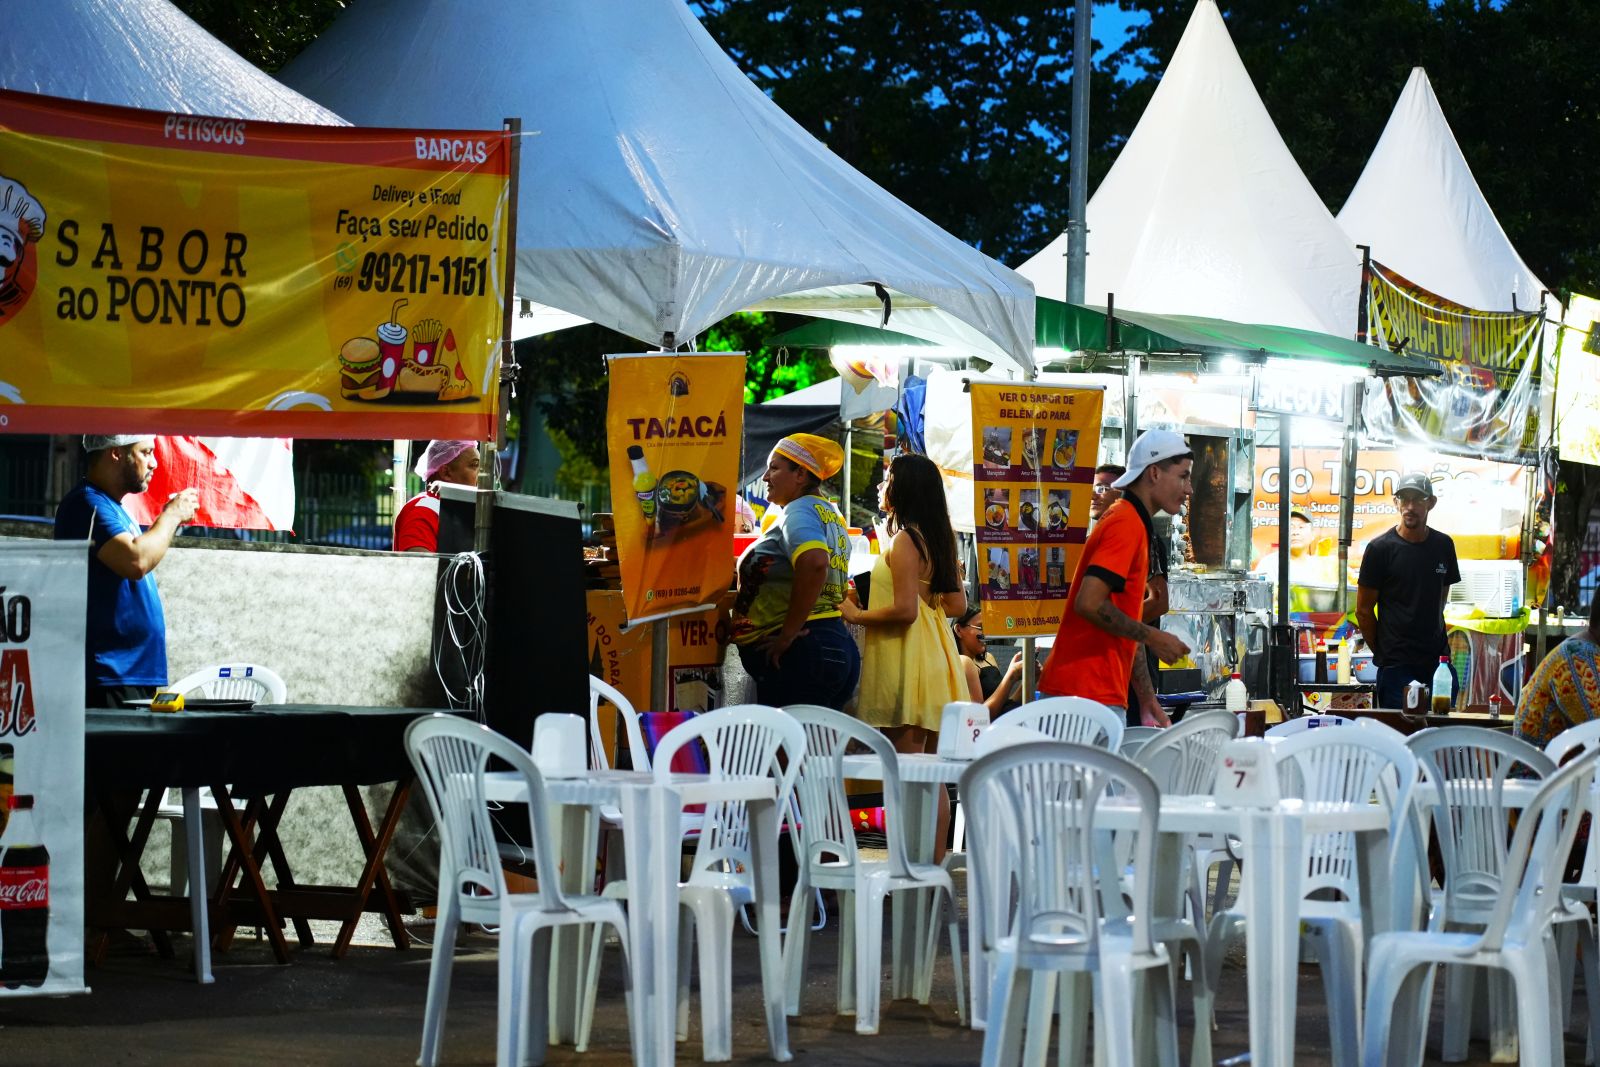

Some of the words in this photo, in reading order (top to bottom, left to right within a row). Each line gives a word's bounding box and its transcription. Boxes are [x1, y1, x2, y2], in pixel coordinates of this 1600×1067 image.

[163, 114, 247, 146] PETISCOS
[414, 136, 487, 164] BARCAS
[372, 184, 415, 208] Delivey
[418, 190, 428, 204] e
[430, 187, 462, 206] iFood
[335, 208, 382, 243] Faça
[388, 217, 423, 239] seu
[423, 214, 489, 242] Pedido
[56, 219, 248, 278] SABOR
[333, 275, 354, 291] (69)
[357, 250, 489, 297] 99217-1151
[56, 286, 99, 321] ao
[106, 275, 247, 328] PONTO
[999, 392, 1018, 402] VER
[1020, 393, 1027, 402] O
[1029, 393, 1061, 405] SABOR
[1063, 395, 1075, 405] DE
[999, 407, 1034, 419] BELÉM
[1036, 410, 1048, 420] DO
[1049, 409, 1071, 420] PARÁ
[626, 410, 727, 440] TACACÁ
[1233, 770, 1246, 789] 7
